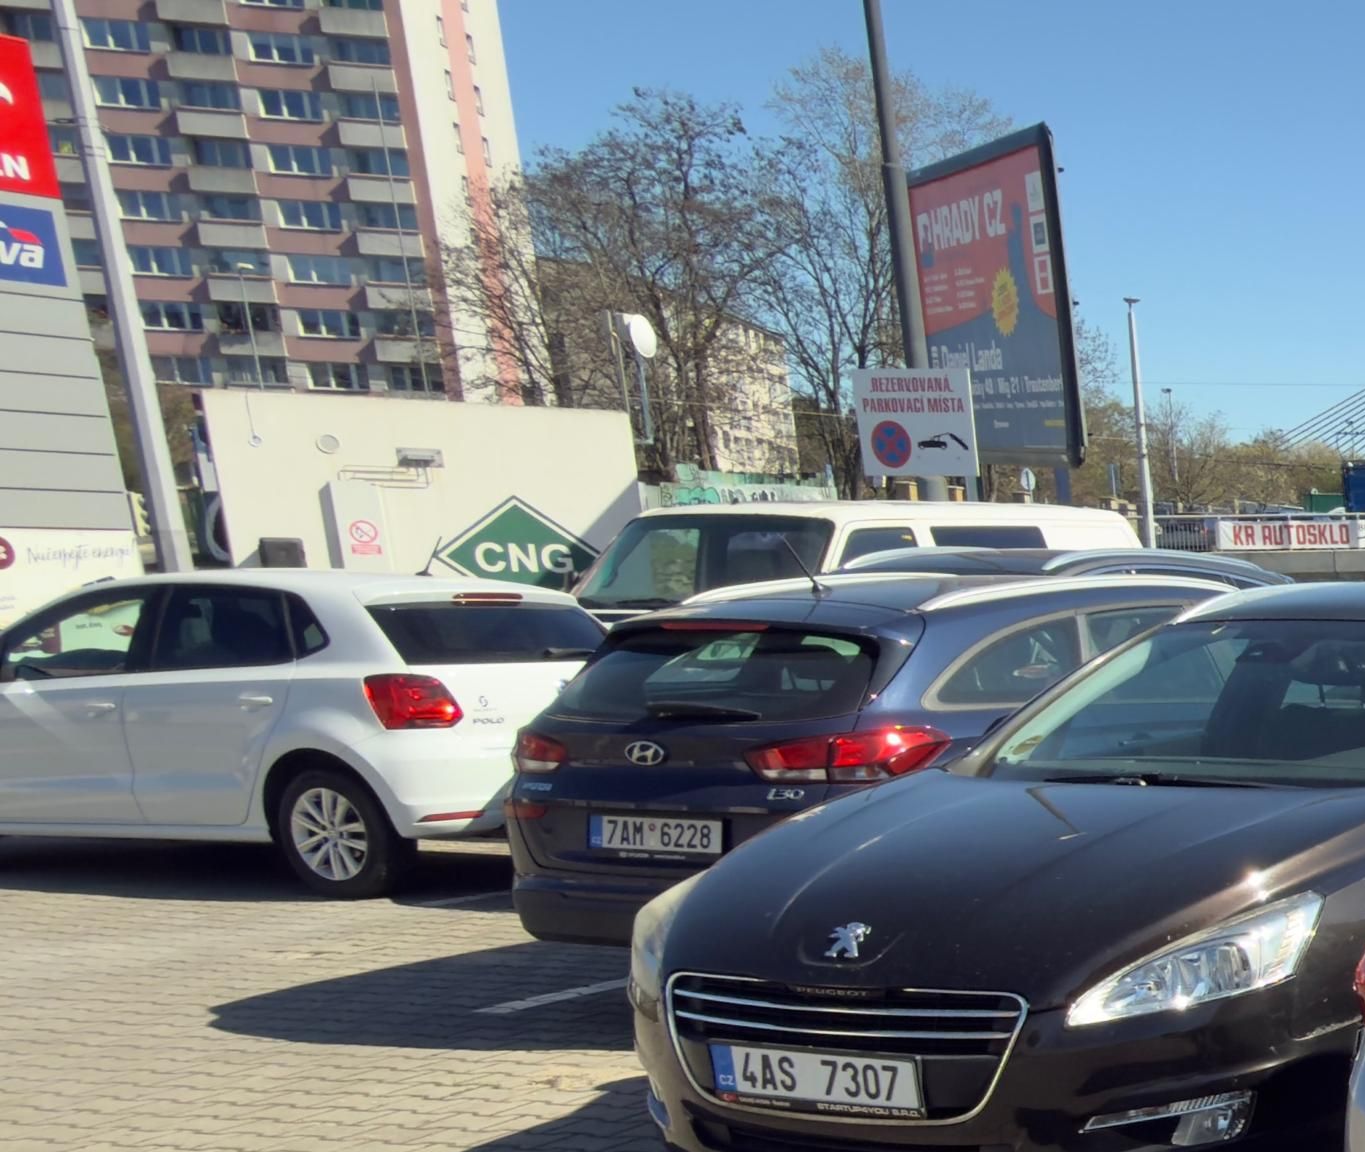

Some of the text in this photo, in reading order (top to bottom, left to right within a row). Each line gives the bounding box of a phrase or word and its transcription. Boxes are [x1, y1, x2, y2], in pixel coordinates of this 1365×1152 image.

[931, 195, 981, 250] HRADY
[972, 339, 1003, 371] Landa
[872, 374, 950, 393] REZERVOVANÁ
[863, 397, 924, 413] PARKOVACÍ
[928, 396, 965, 413] MÍSTA
[1232, 523, 1350, 546] KR AUTOSKLO
[473, 541, 574, 574] CNG
[607, 820, 712, 849] 7AM 6228
[796, 986, 869, 997] PEUGEOT
[719, 1074, 735, 1086] CZ
[742, 1052, 898, 1102] 4AS 7307
